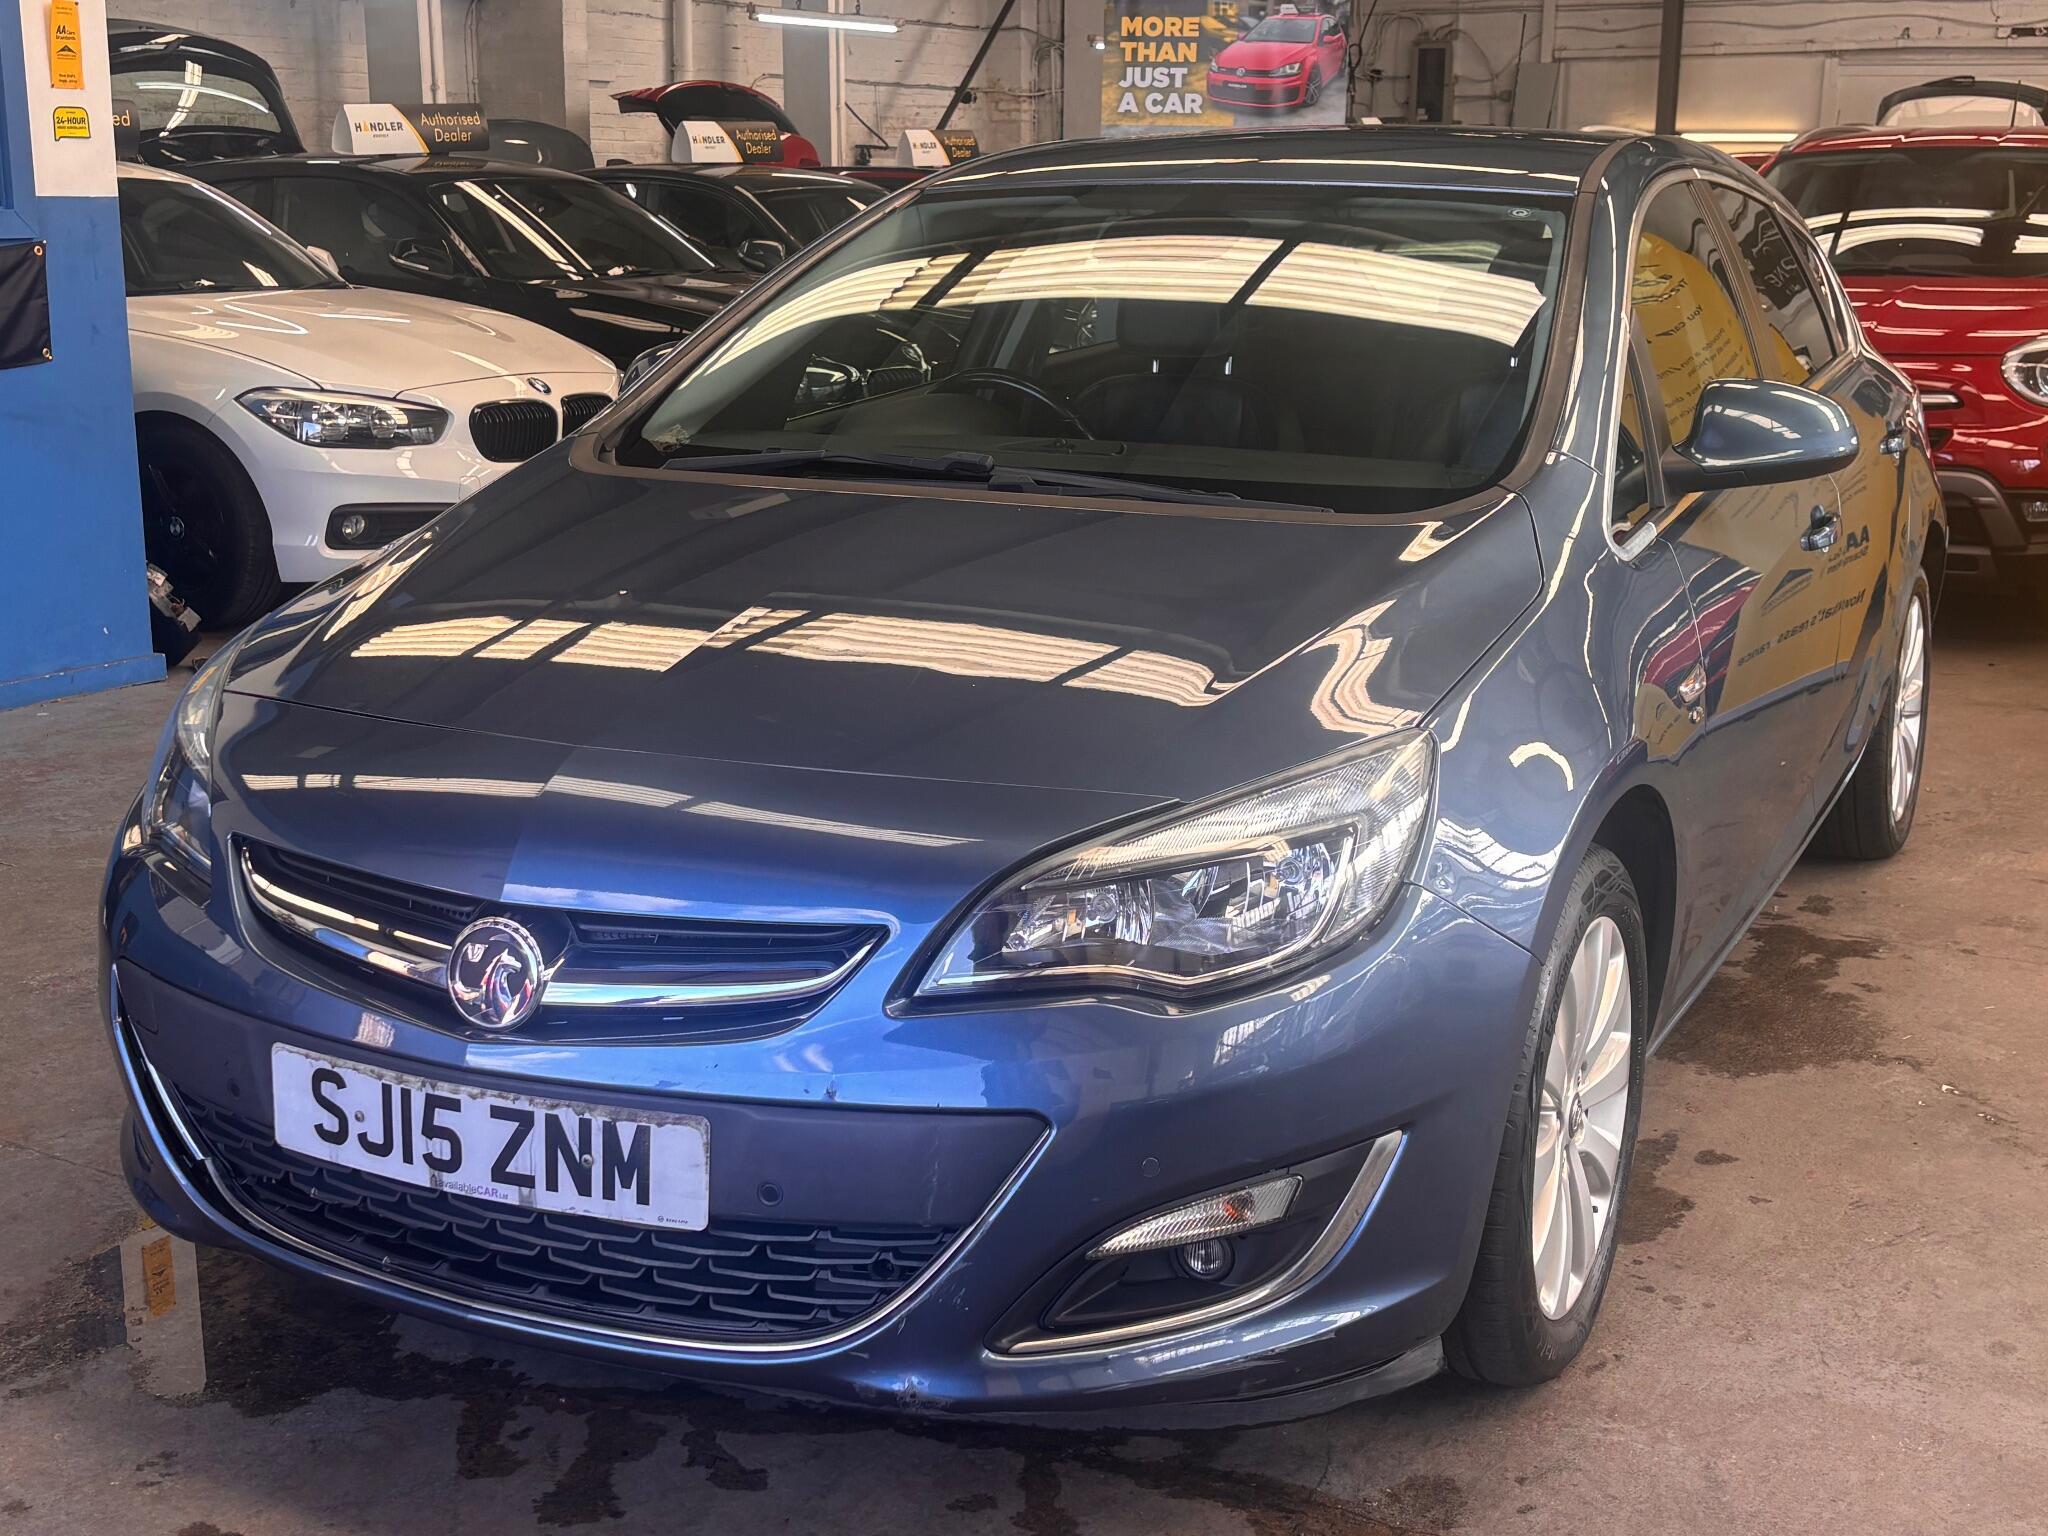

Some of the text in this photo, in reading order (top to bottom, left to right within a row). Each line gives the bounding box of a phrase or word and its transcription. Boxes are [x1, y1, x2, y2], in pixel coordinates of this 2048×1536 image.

[1121, 16, 1200, 37] MORE
[1120, 41, 1198, 63] THAN
[1119, 67, 1188, 88] JUST
[1117, 92, 1203, 114] A CAR
[56, 117, 86, 125] 24-HOUR
[421, 112, 481, 127] Authorised
[435, 128, 472, 142] Dealer
[736, 128, 777, 141] Authorised
[745, 142, 772, 155] Dealer
[310, 1066, 651, 1206] SJ15 ZNM
